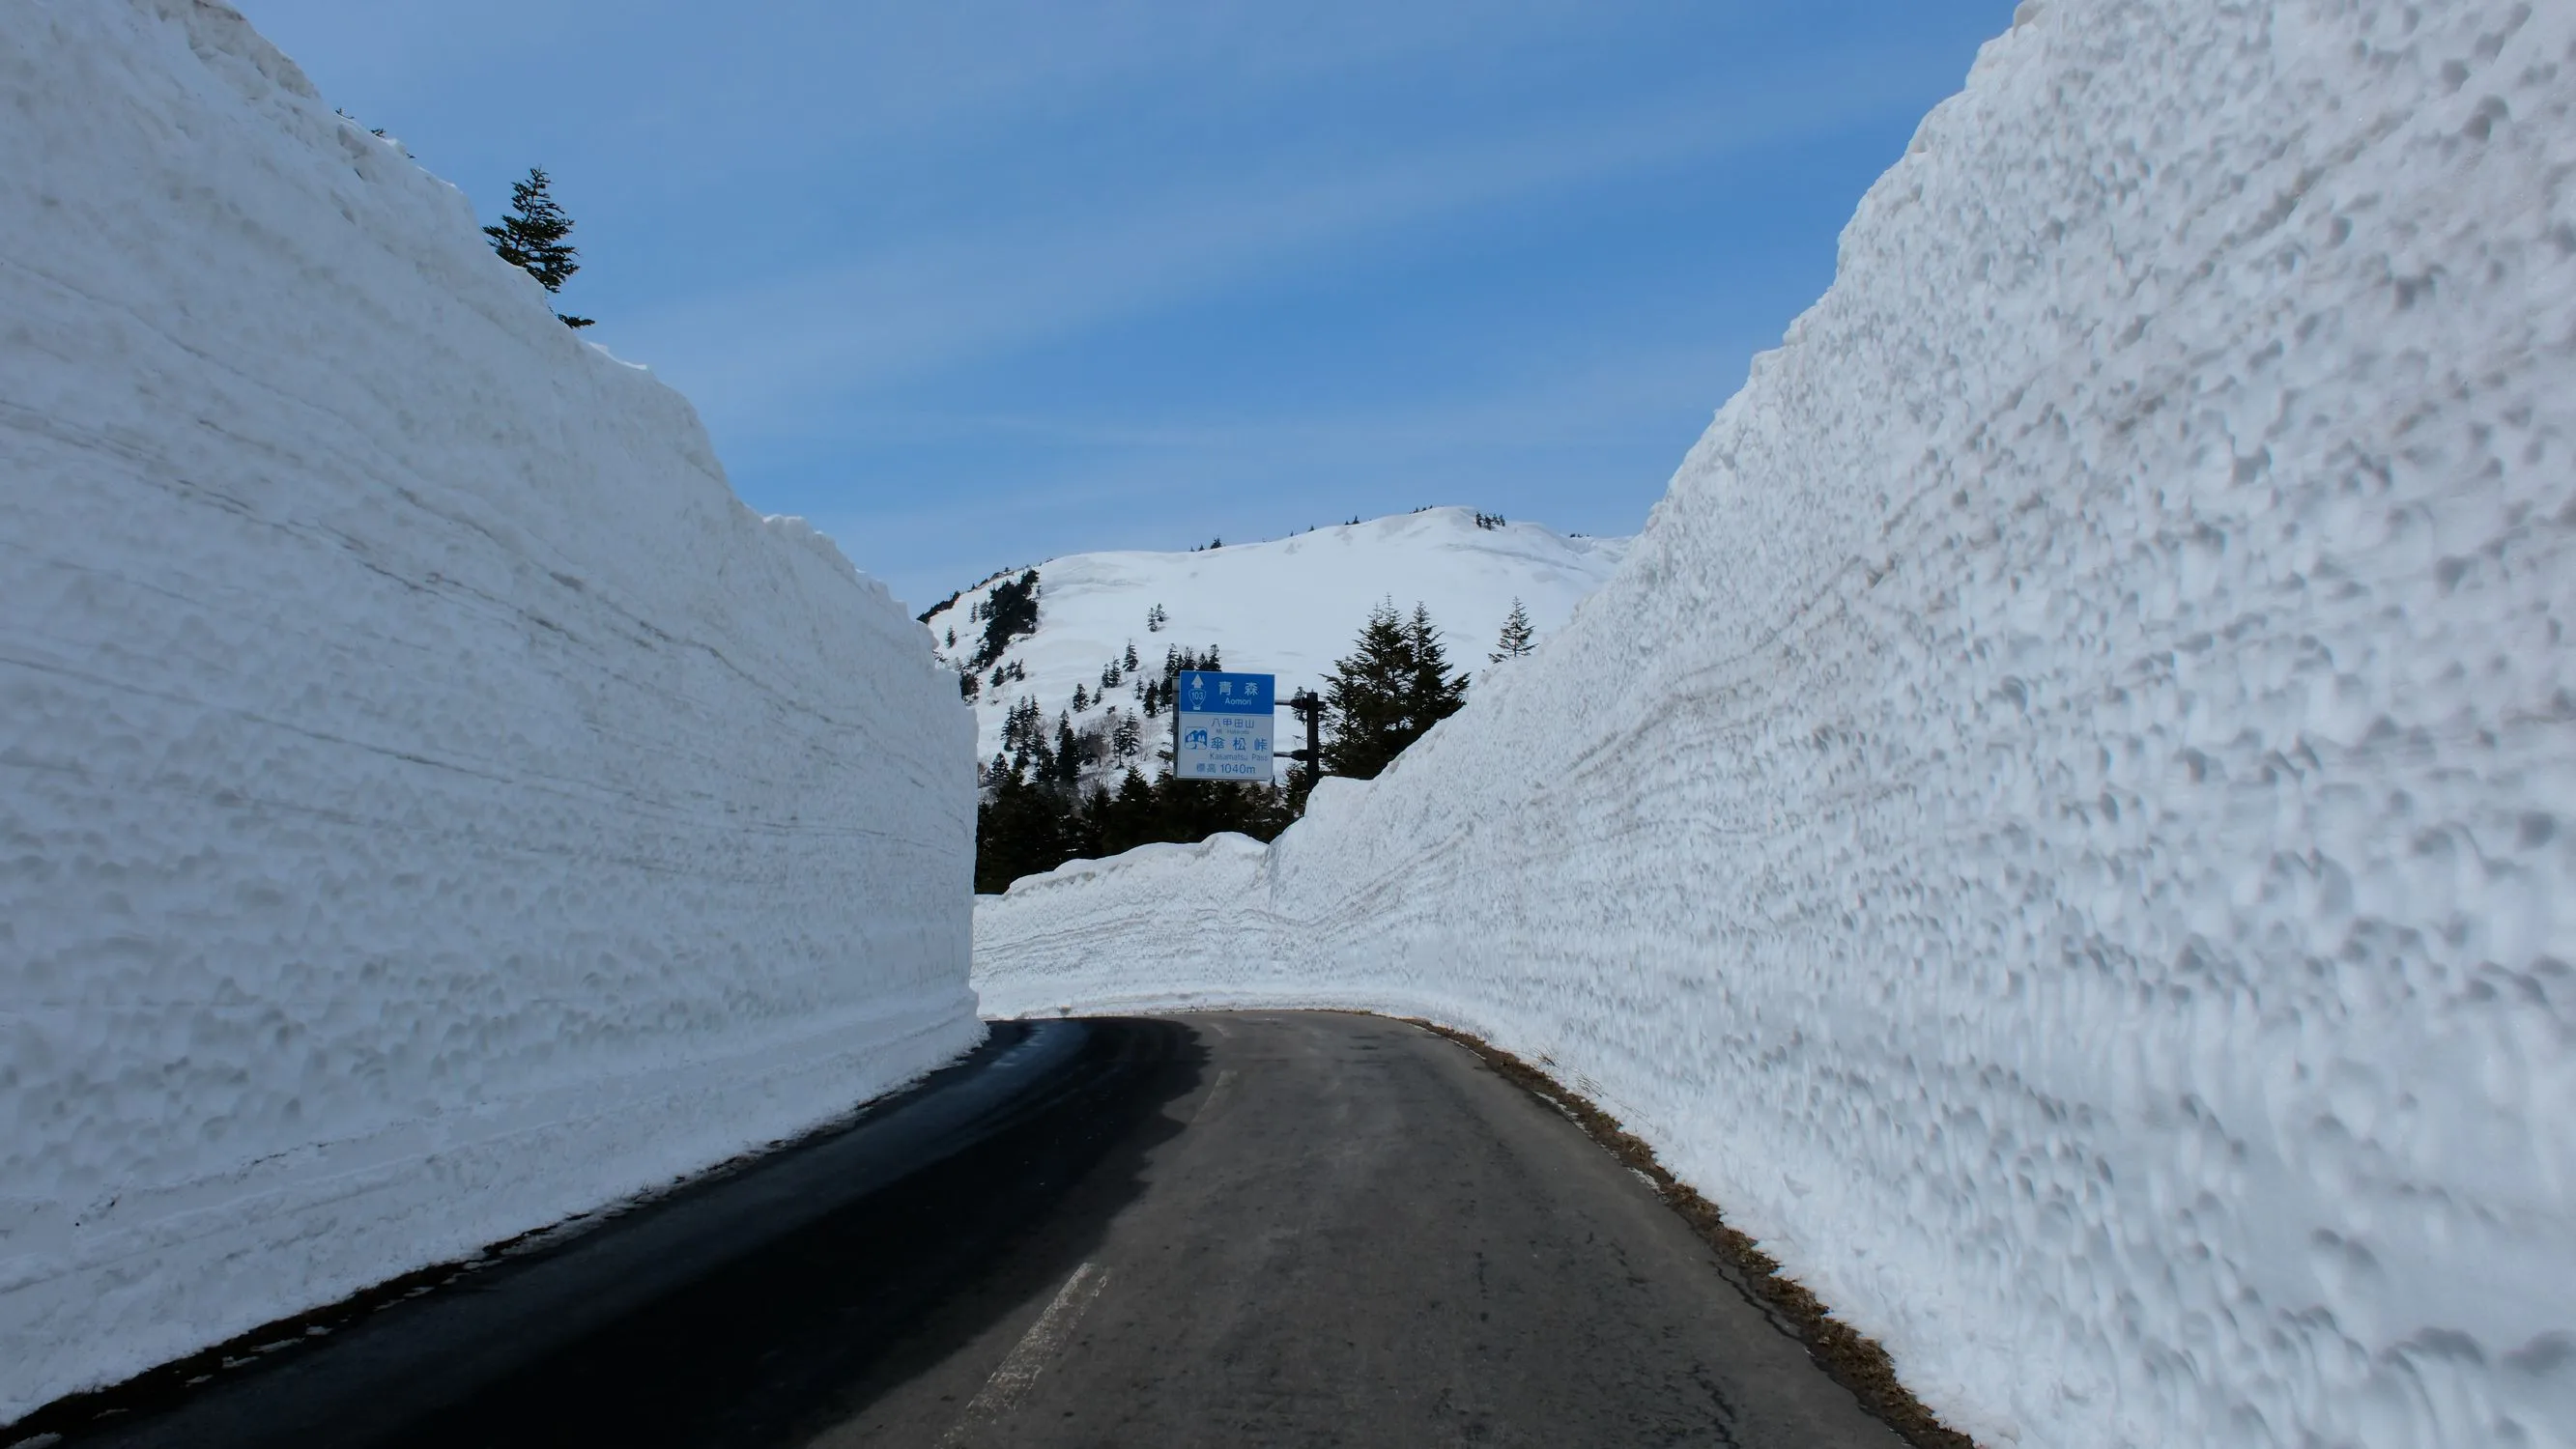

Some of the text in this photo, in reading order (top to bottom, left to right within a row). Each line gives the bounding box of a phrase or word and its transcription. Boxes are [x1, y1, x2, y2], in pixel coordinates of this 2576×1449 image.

[1218, 681, 1259, 696] 青森
[1191, 692, 1203, 700] 103
[1212, 719, 1254, 728] 八甲田山
[1211, 737, 1268, 752] 傘松峠
[1221, 764, 1255, 774] 1040m
